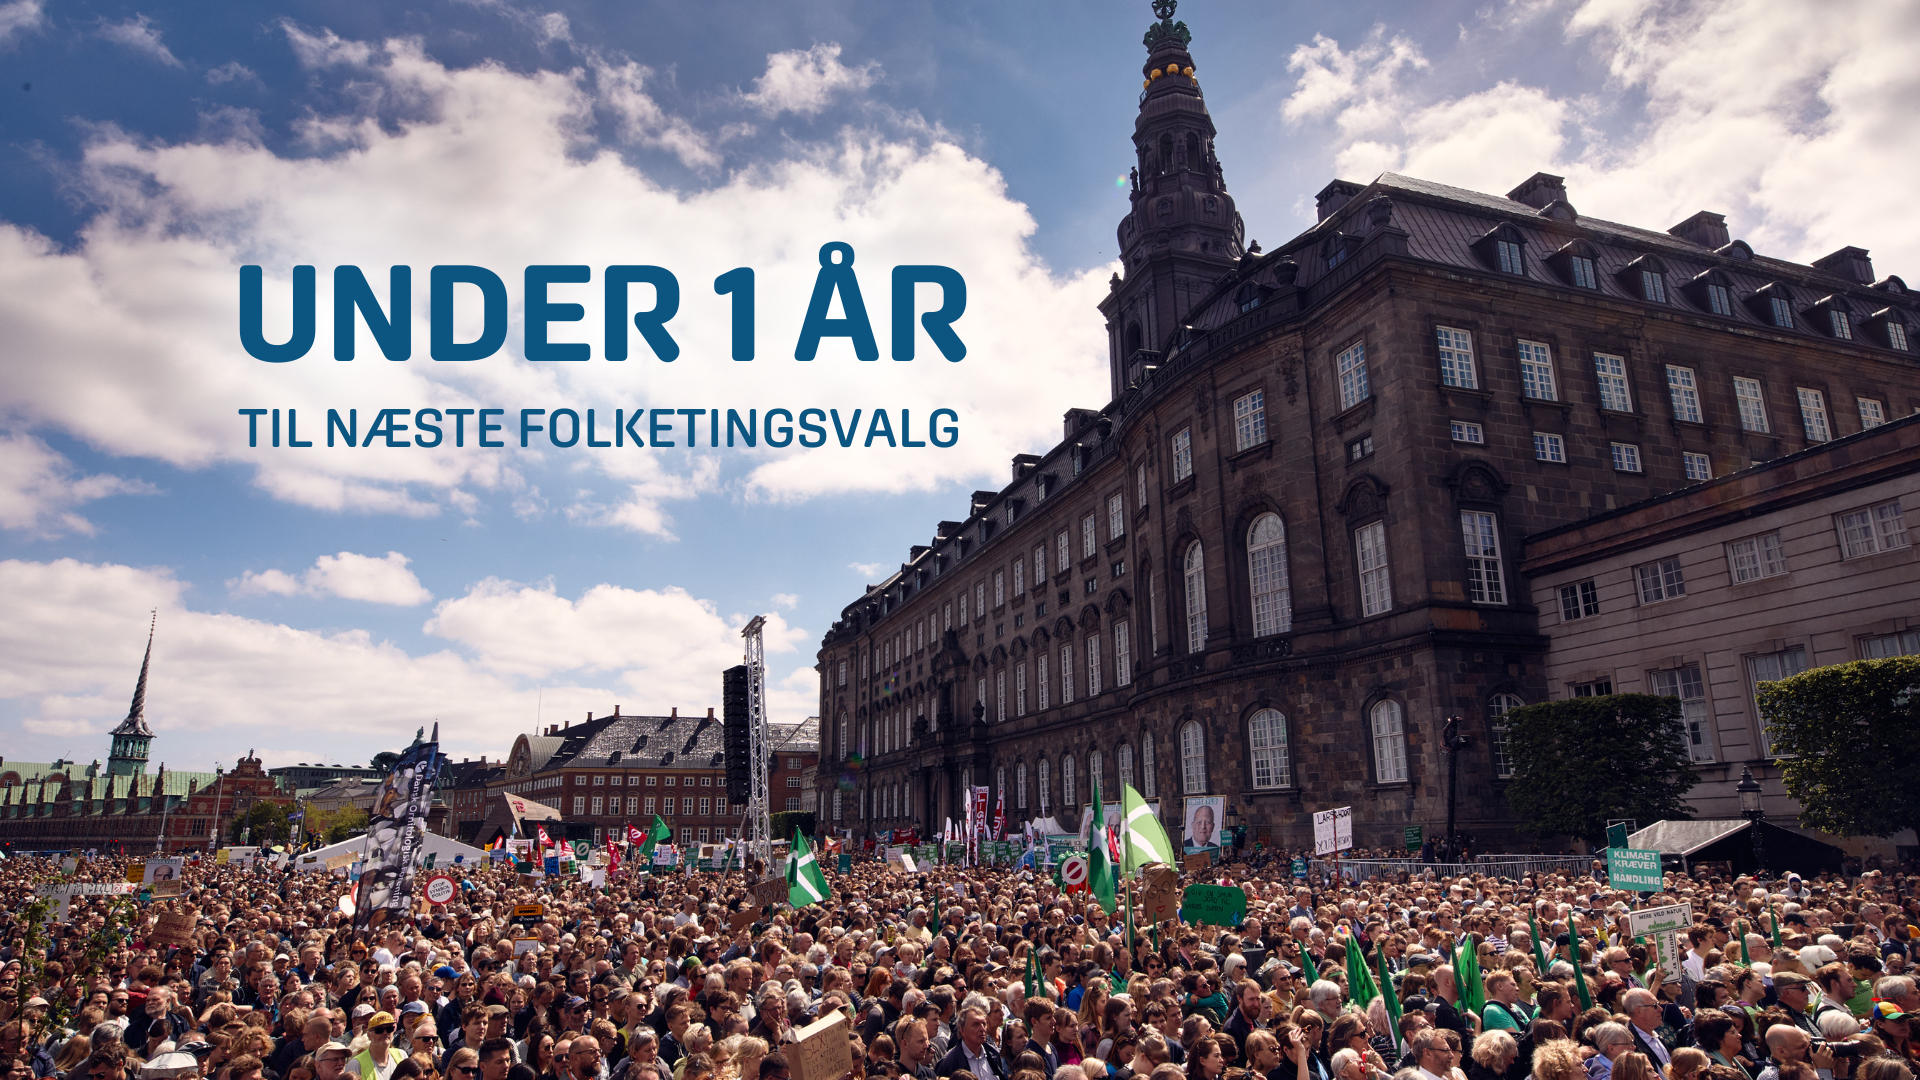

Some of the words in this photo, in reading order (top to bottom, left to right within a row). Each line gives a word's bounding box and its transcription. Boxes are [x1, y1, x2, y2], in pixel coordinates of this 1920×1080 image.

[410, 774, 424, 803] Dansk
[401, 805, 418, 865] Ornitologisk
[1613, 850, 1657, 861] KLIMAET
[1614, 859, 1657, 870] KRÆVER
[432, 881, 446, 889] STOP
[1613, 873, 1661, 886] HANDLING
[41, 884, 68, 895] STEM
[431, 888, 451, 899] POLITIK
[1190, 888, 1202, 896] GIV
[1672, 962, 1678, 970] BY
[802, 1033, 826, 1060] SEX
[820, 1041, 847, 1058] ATTENTION
[826, 1053, 840, 1065] TALK
